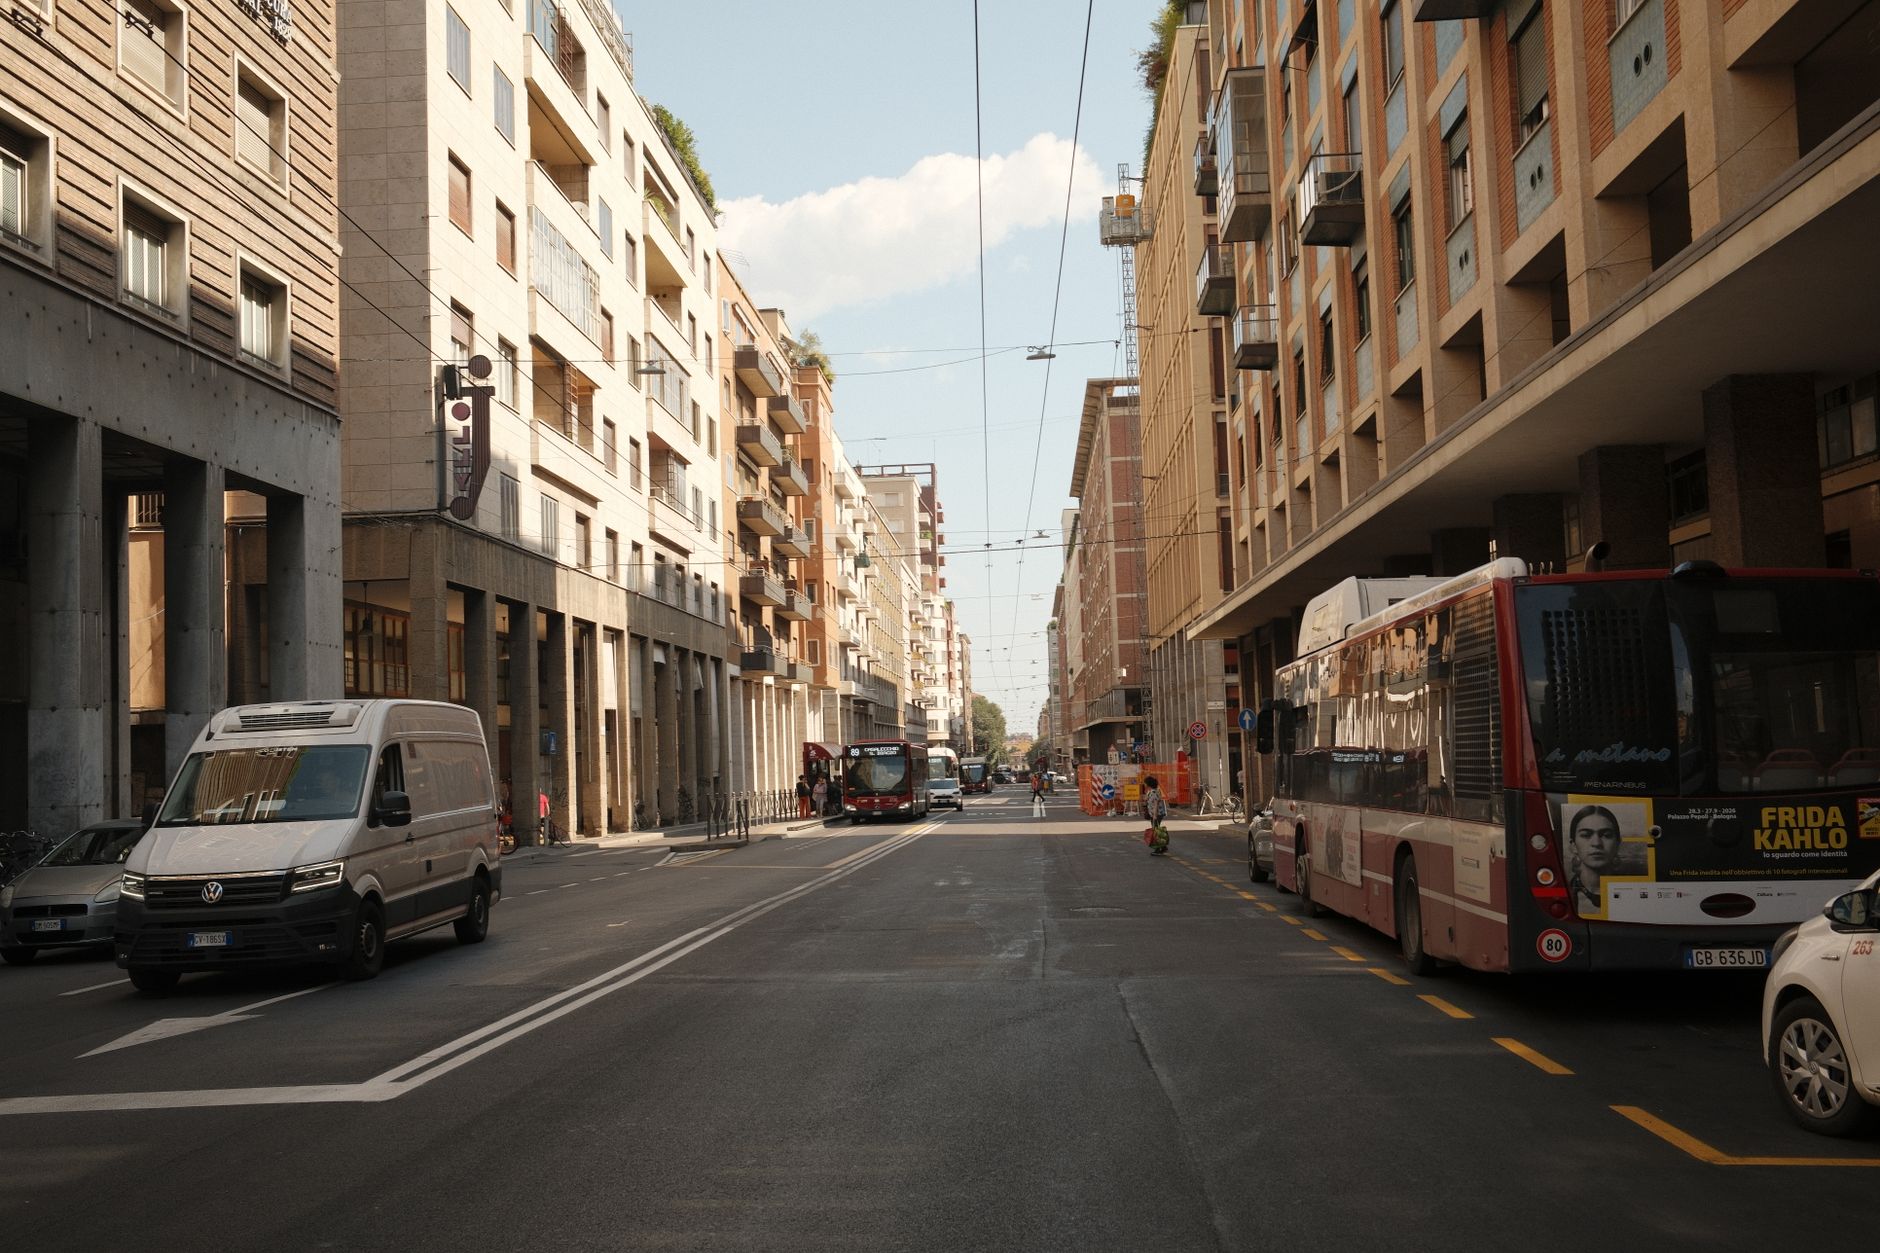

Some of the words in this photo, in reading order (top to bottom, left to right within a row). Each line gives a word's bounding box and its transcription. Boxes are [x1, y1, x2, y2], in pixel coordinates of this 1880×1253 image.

[850, 748, 860, 757] 89
[1761, 806, 1845, 828] FRIDA
[1754, 828, 1848, 851] KAHLO
[1772, 851, 1799, 859] sguardo
[1820, 850, 1848, 858] identità
[1546, 938, 1562, 952] 80
[1852, 941, 1873, 955] 263
[1695, 950, 1714, 966] GB
[1719, 949, 1764, 965] 636JD
